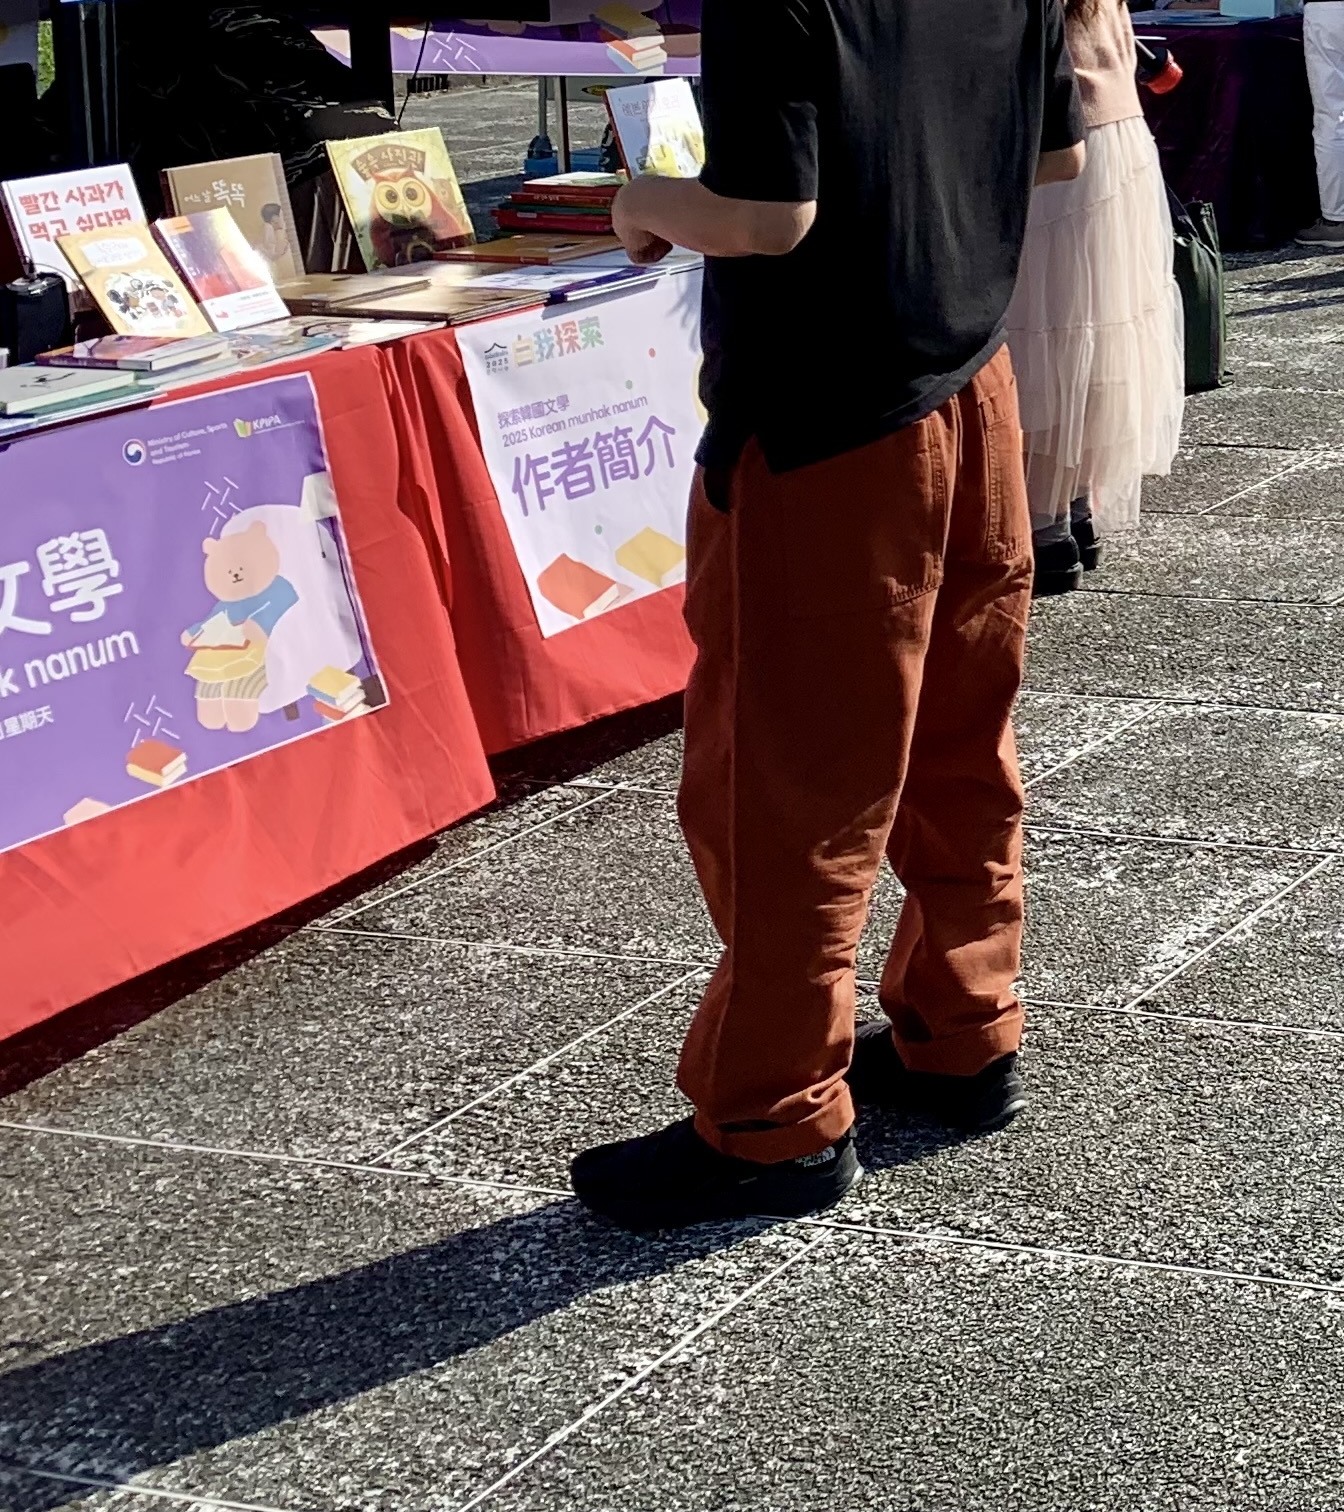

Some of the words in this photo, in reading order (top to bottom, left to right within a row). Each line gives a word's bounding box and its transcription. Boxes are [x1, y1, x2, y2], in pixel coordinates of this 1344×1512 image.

[19, 190, 61, 216] 빨간
[65, 180, 125, 206] 사과가
[212, 178, 246, 208] 똑똑
[29, 219, 70, 242] 먹고
[512, 316, 604, 368] 自我探索
[252, 414, 282, 431] KPIPA
[498, 394, 570, 429] 探索韓國文學
[502, 428, 529, 448] 2025
[529, 419, 567, 440] Korean
[567, 404, 612, 425] munhak
[613, 395, 649, 415] nanum
[511, 415, 676, 517] 作者簡介
[24, 630, 140, 689] nanum
[0, 704, 54, 739] 星期天
